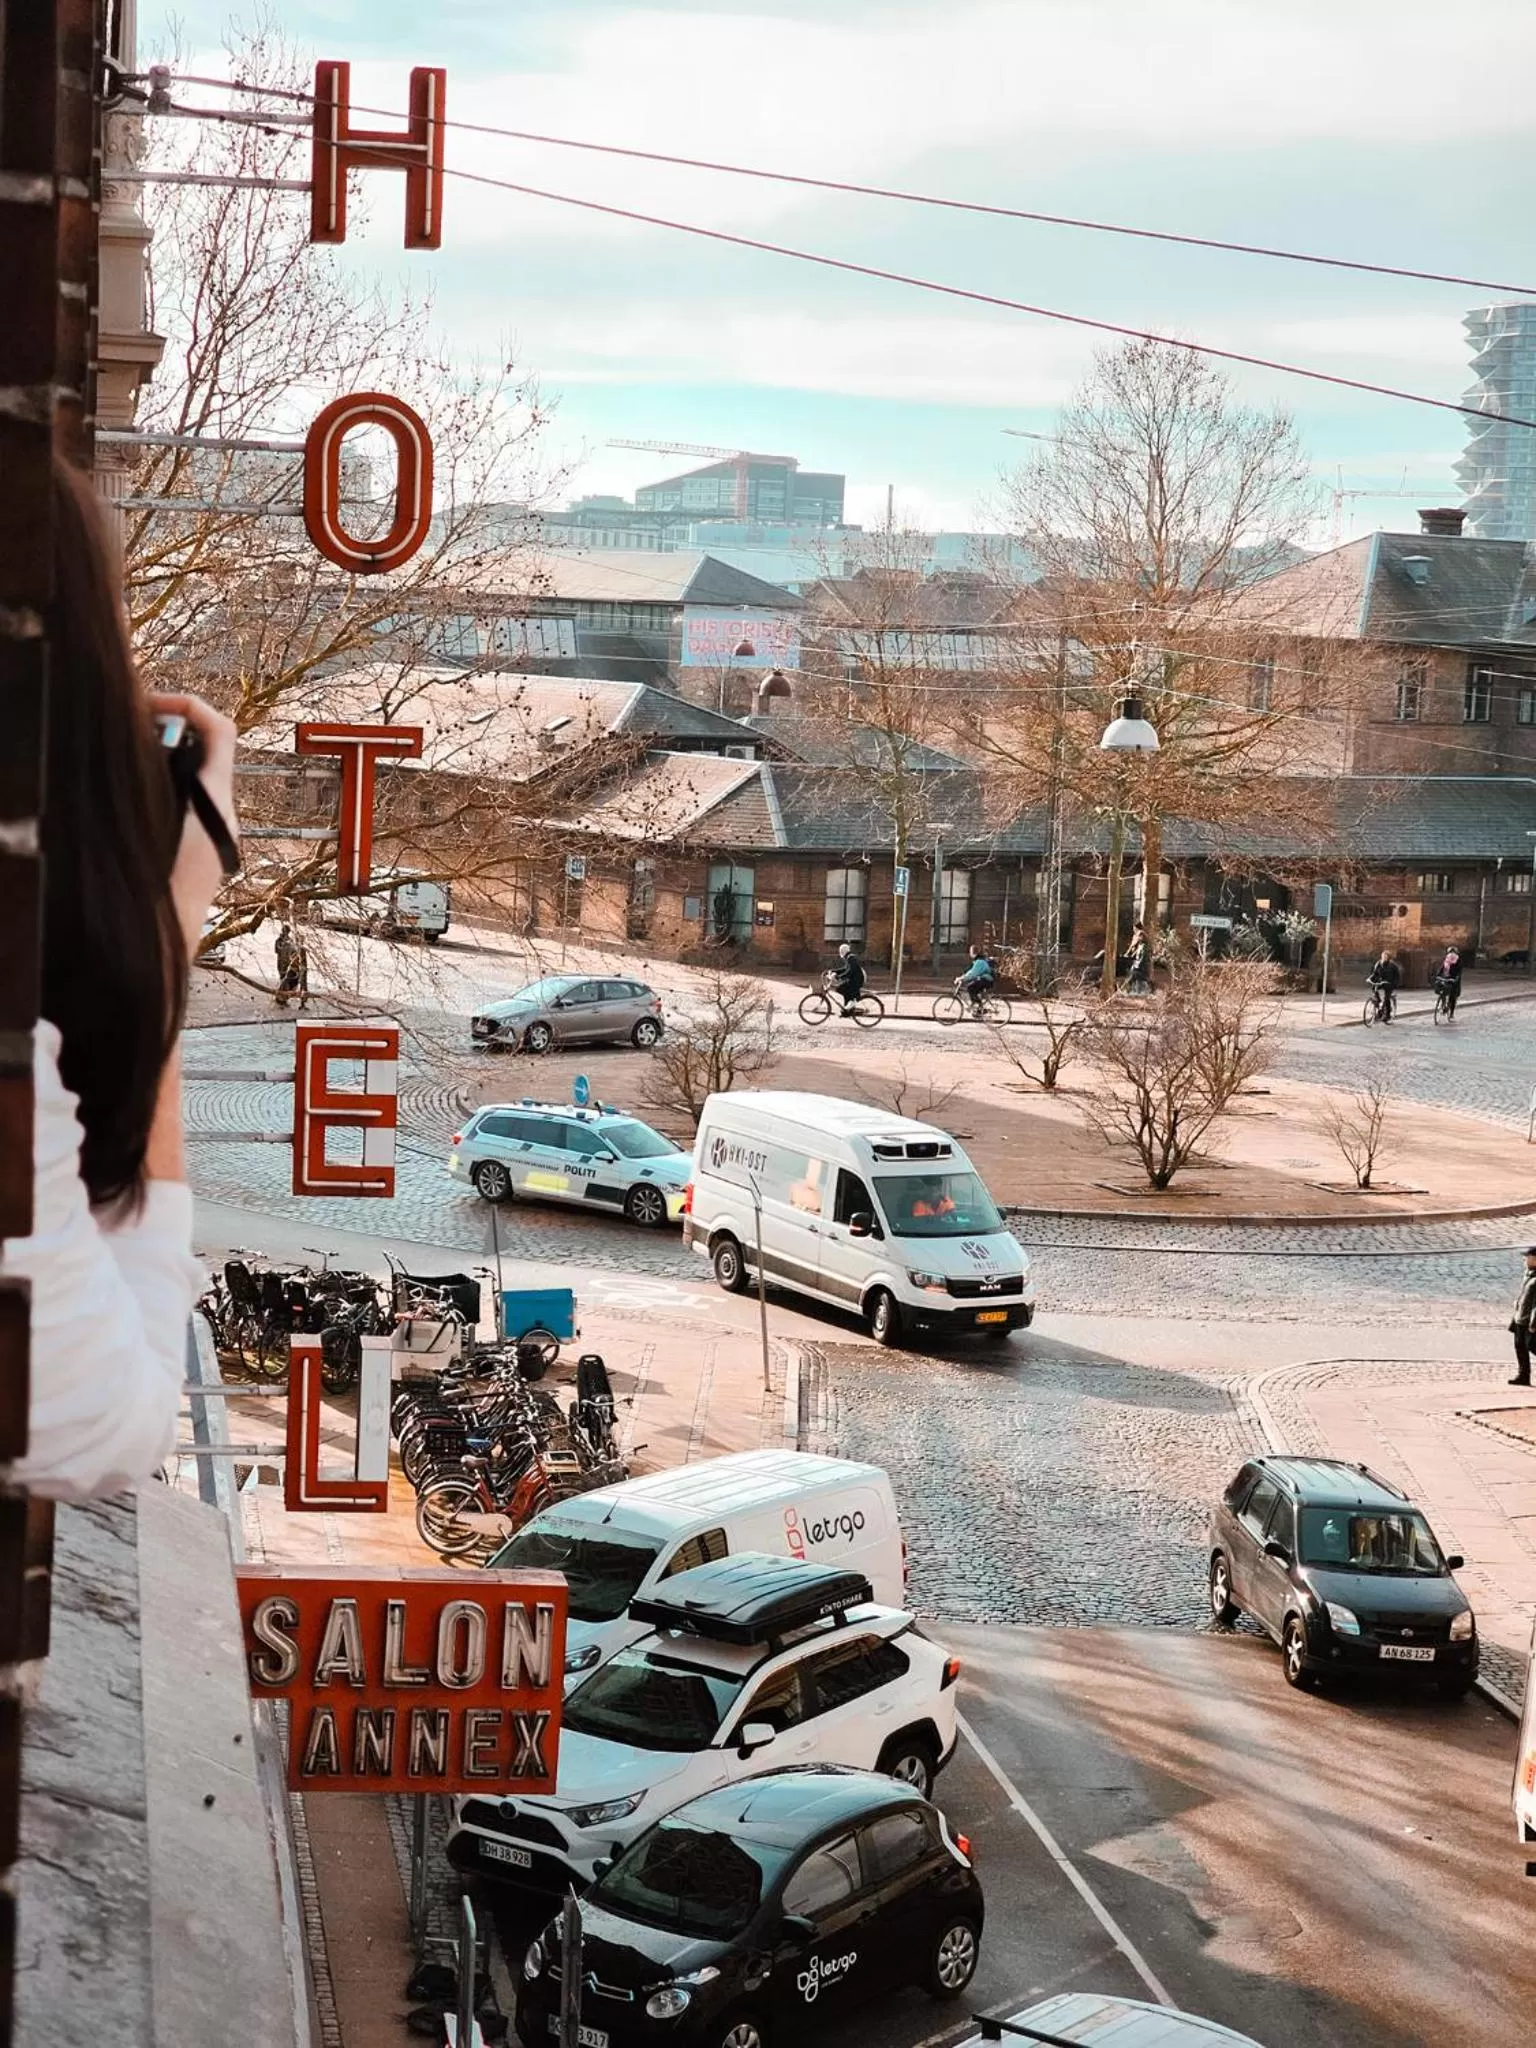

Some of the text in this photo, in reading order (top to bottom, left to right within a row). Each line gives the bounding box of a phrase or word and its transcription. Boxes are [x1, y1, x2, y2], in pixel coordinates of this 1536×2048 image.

[284, 60, 445, 1512] HOTEL
[563, 1163, 597, 1179] POLITI
[252, 1596, 555, 1690] SALON
[302, 1707, 551, 1780] ANNEX
